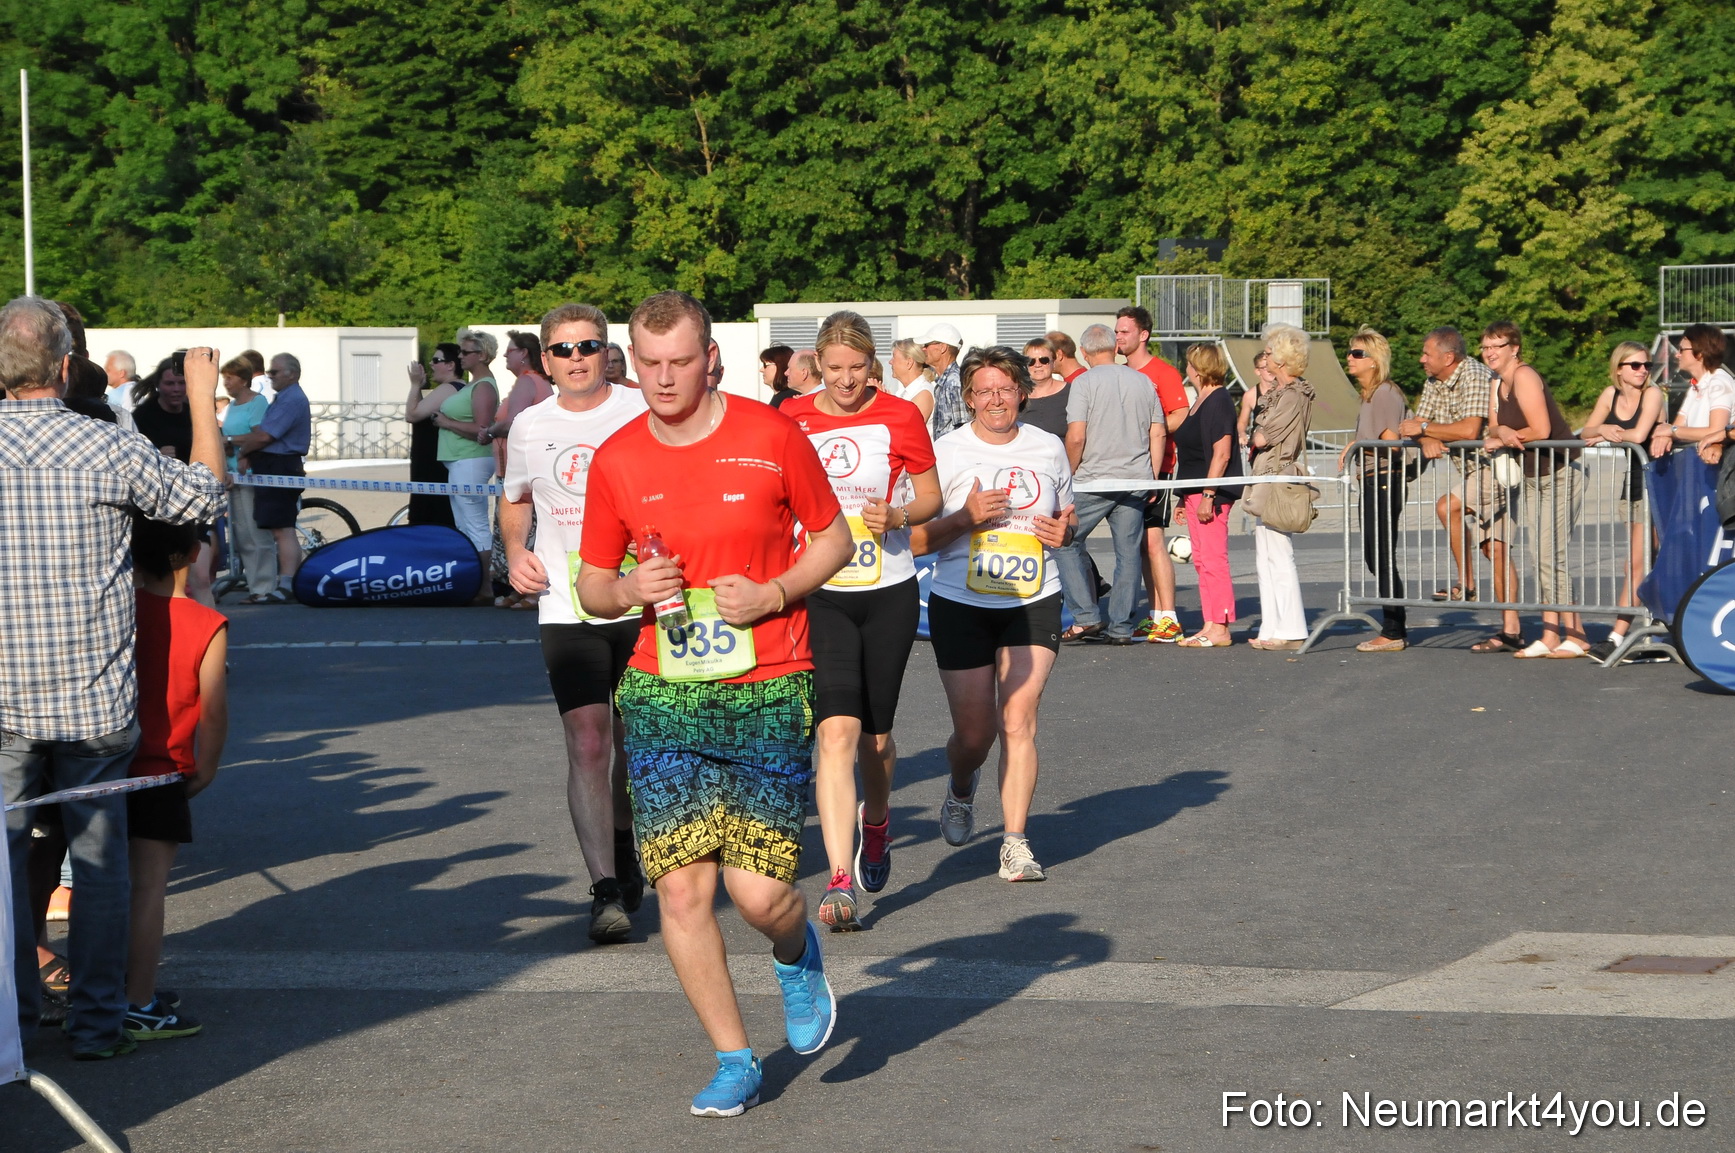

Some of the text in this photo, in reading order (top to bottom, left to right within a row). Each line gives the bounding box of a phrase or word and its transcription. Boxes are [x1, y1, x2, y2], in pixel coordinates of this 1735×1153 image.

[723, 492, 745, 503] Eugen
[344, 560, 458, 597] Fischer
[972, 553, 1037, 582] 1029
[667, 619, 736, 659] 935
